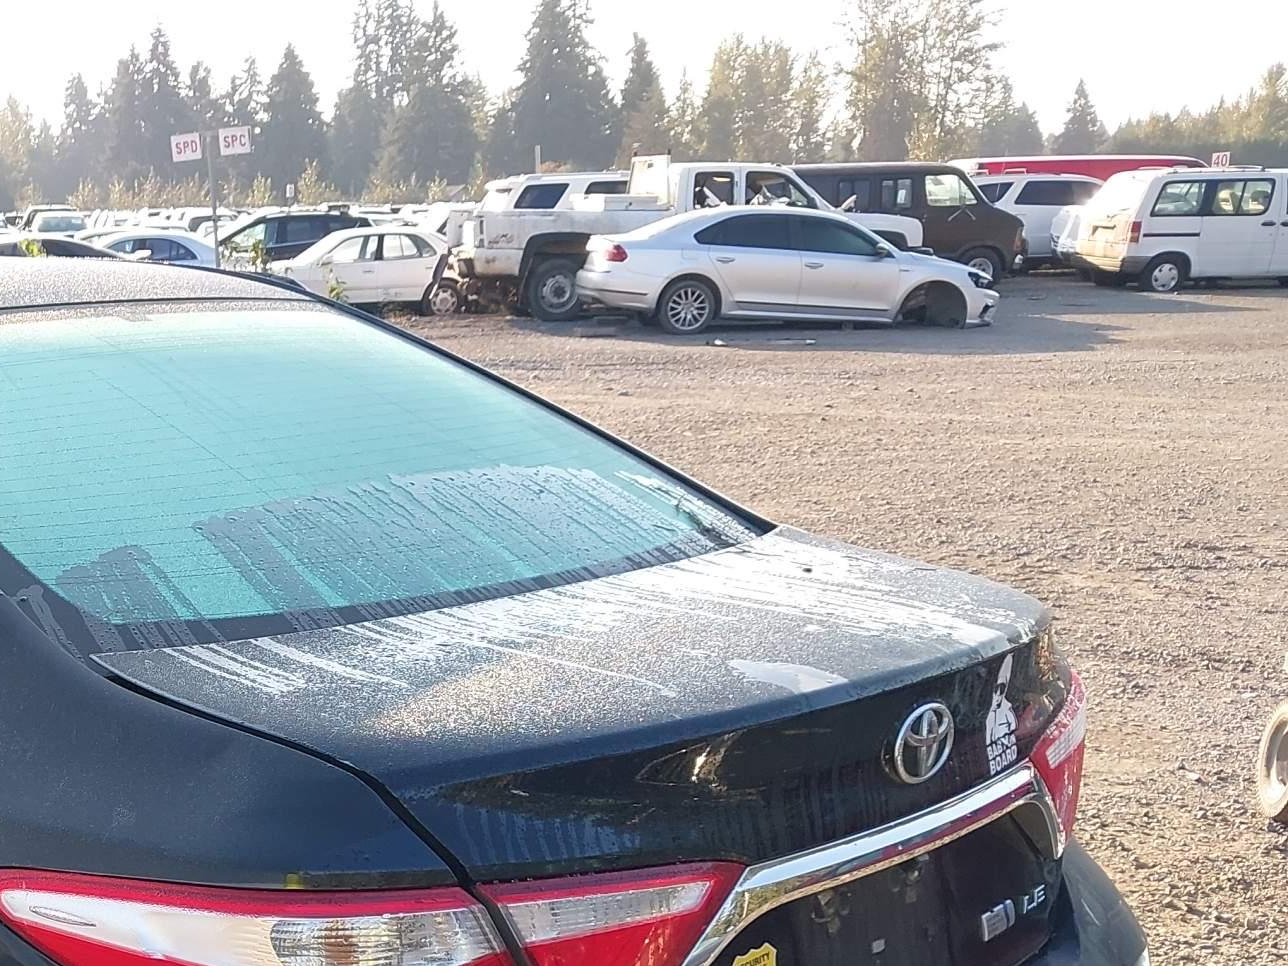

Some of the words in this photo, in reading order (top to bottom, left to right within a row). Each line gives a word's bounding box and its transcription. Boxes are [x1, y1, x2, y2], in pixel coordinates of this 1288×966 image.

[175, 140, 198, 155] SPD
[223, 134, 247, 149] SPC
[1213, 153, 1228, 167] 40
[989, 745, 1018, 776] BOARD
[1023, 884, 1045, 914] LE
